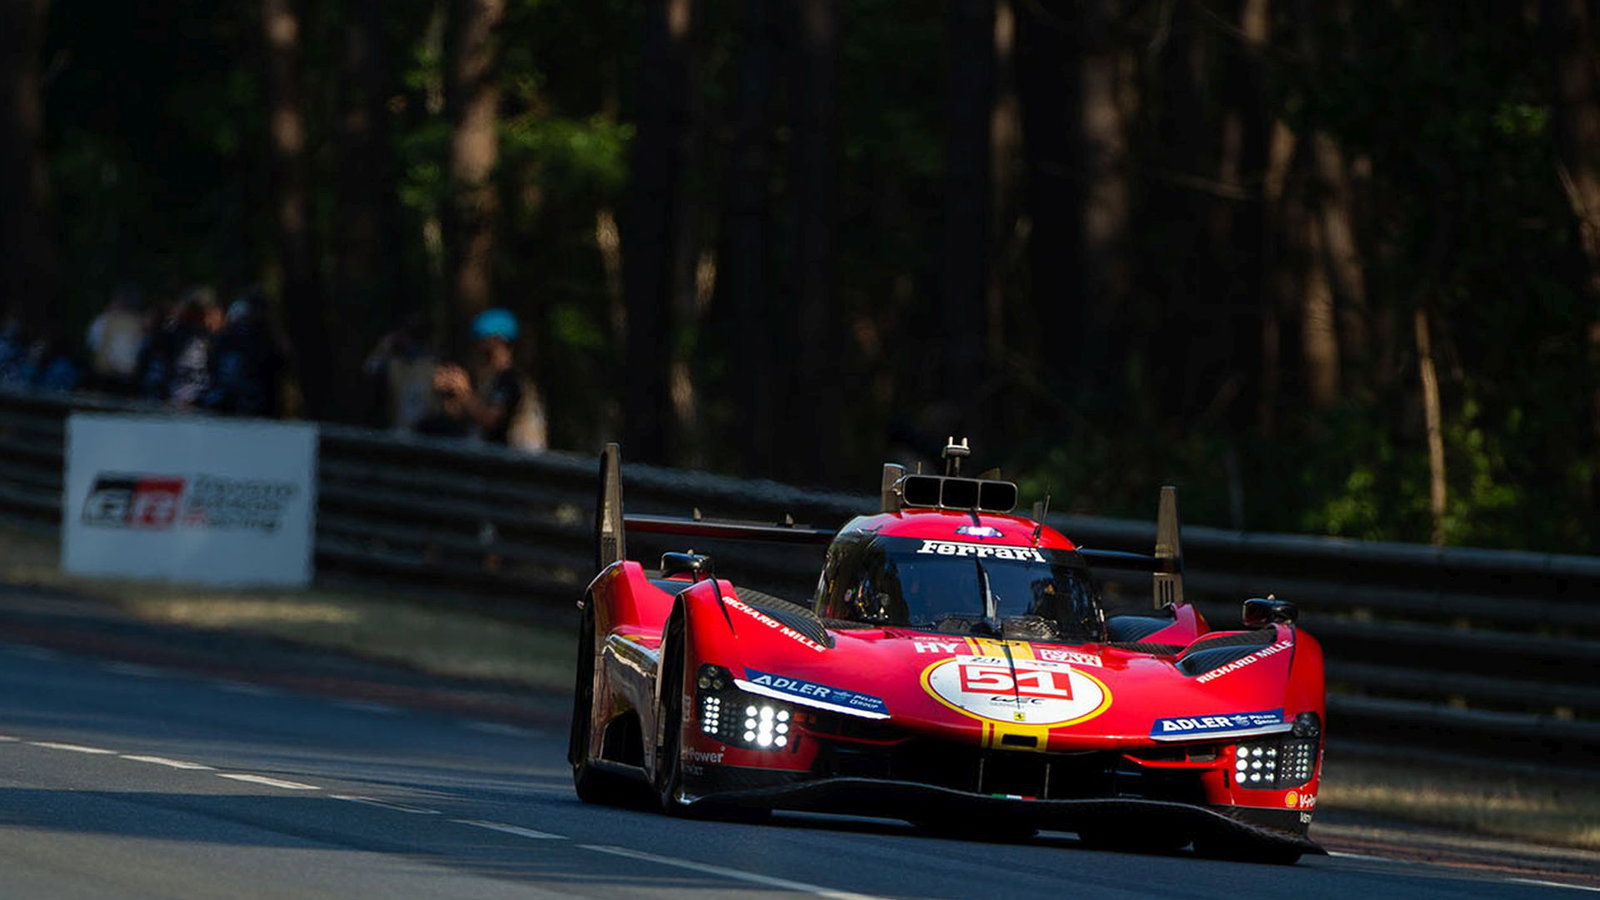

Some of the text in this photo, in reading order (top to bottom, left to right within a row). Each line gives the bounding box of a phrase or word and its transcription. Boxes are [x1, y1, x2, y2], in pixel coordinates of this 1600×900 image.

[916, 539, 1047, 563] Ferrari
[722, 596, 827, 653] RICHARD MILLE
[913, 641, 960, 654] HY
[1195, 639, 1295, 684] RICHARD MILLE
[752, 674, 831, 699] ADLER
[965, 665, 1068, 697] 51
[1161, 716, 1234, 732] ADLER
